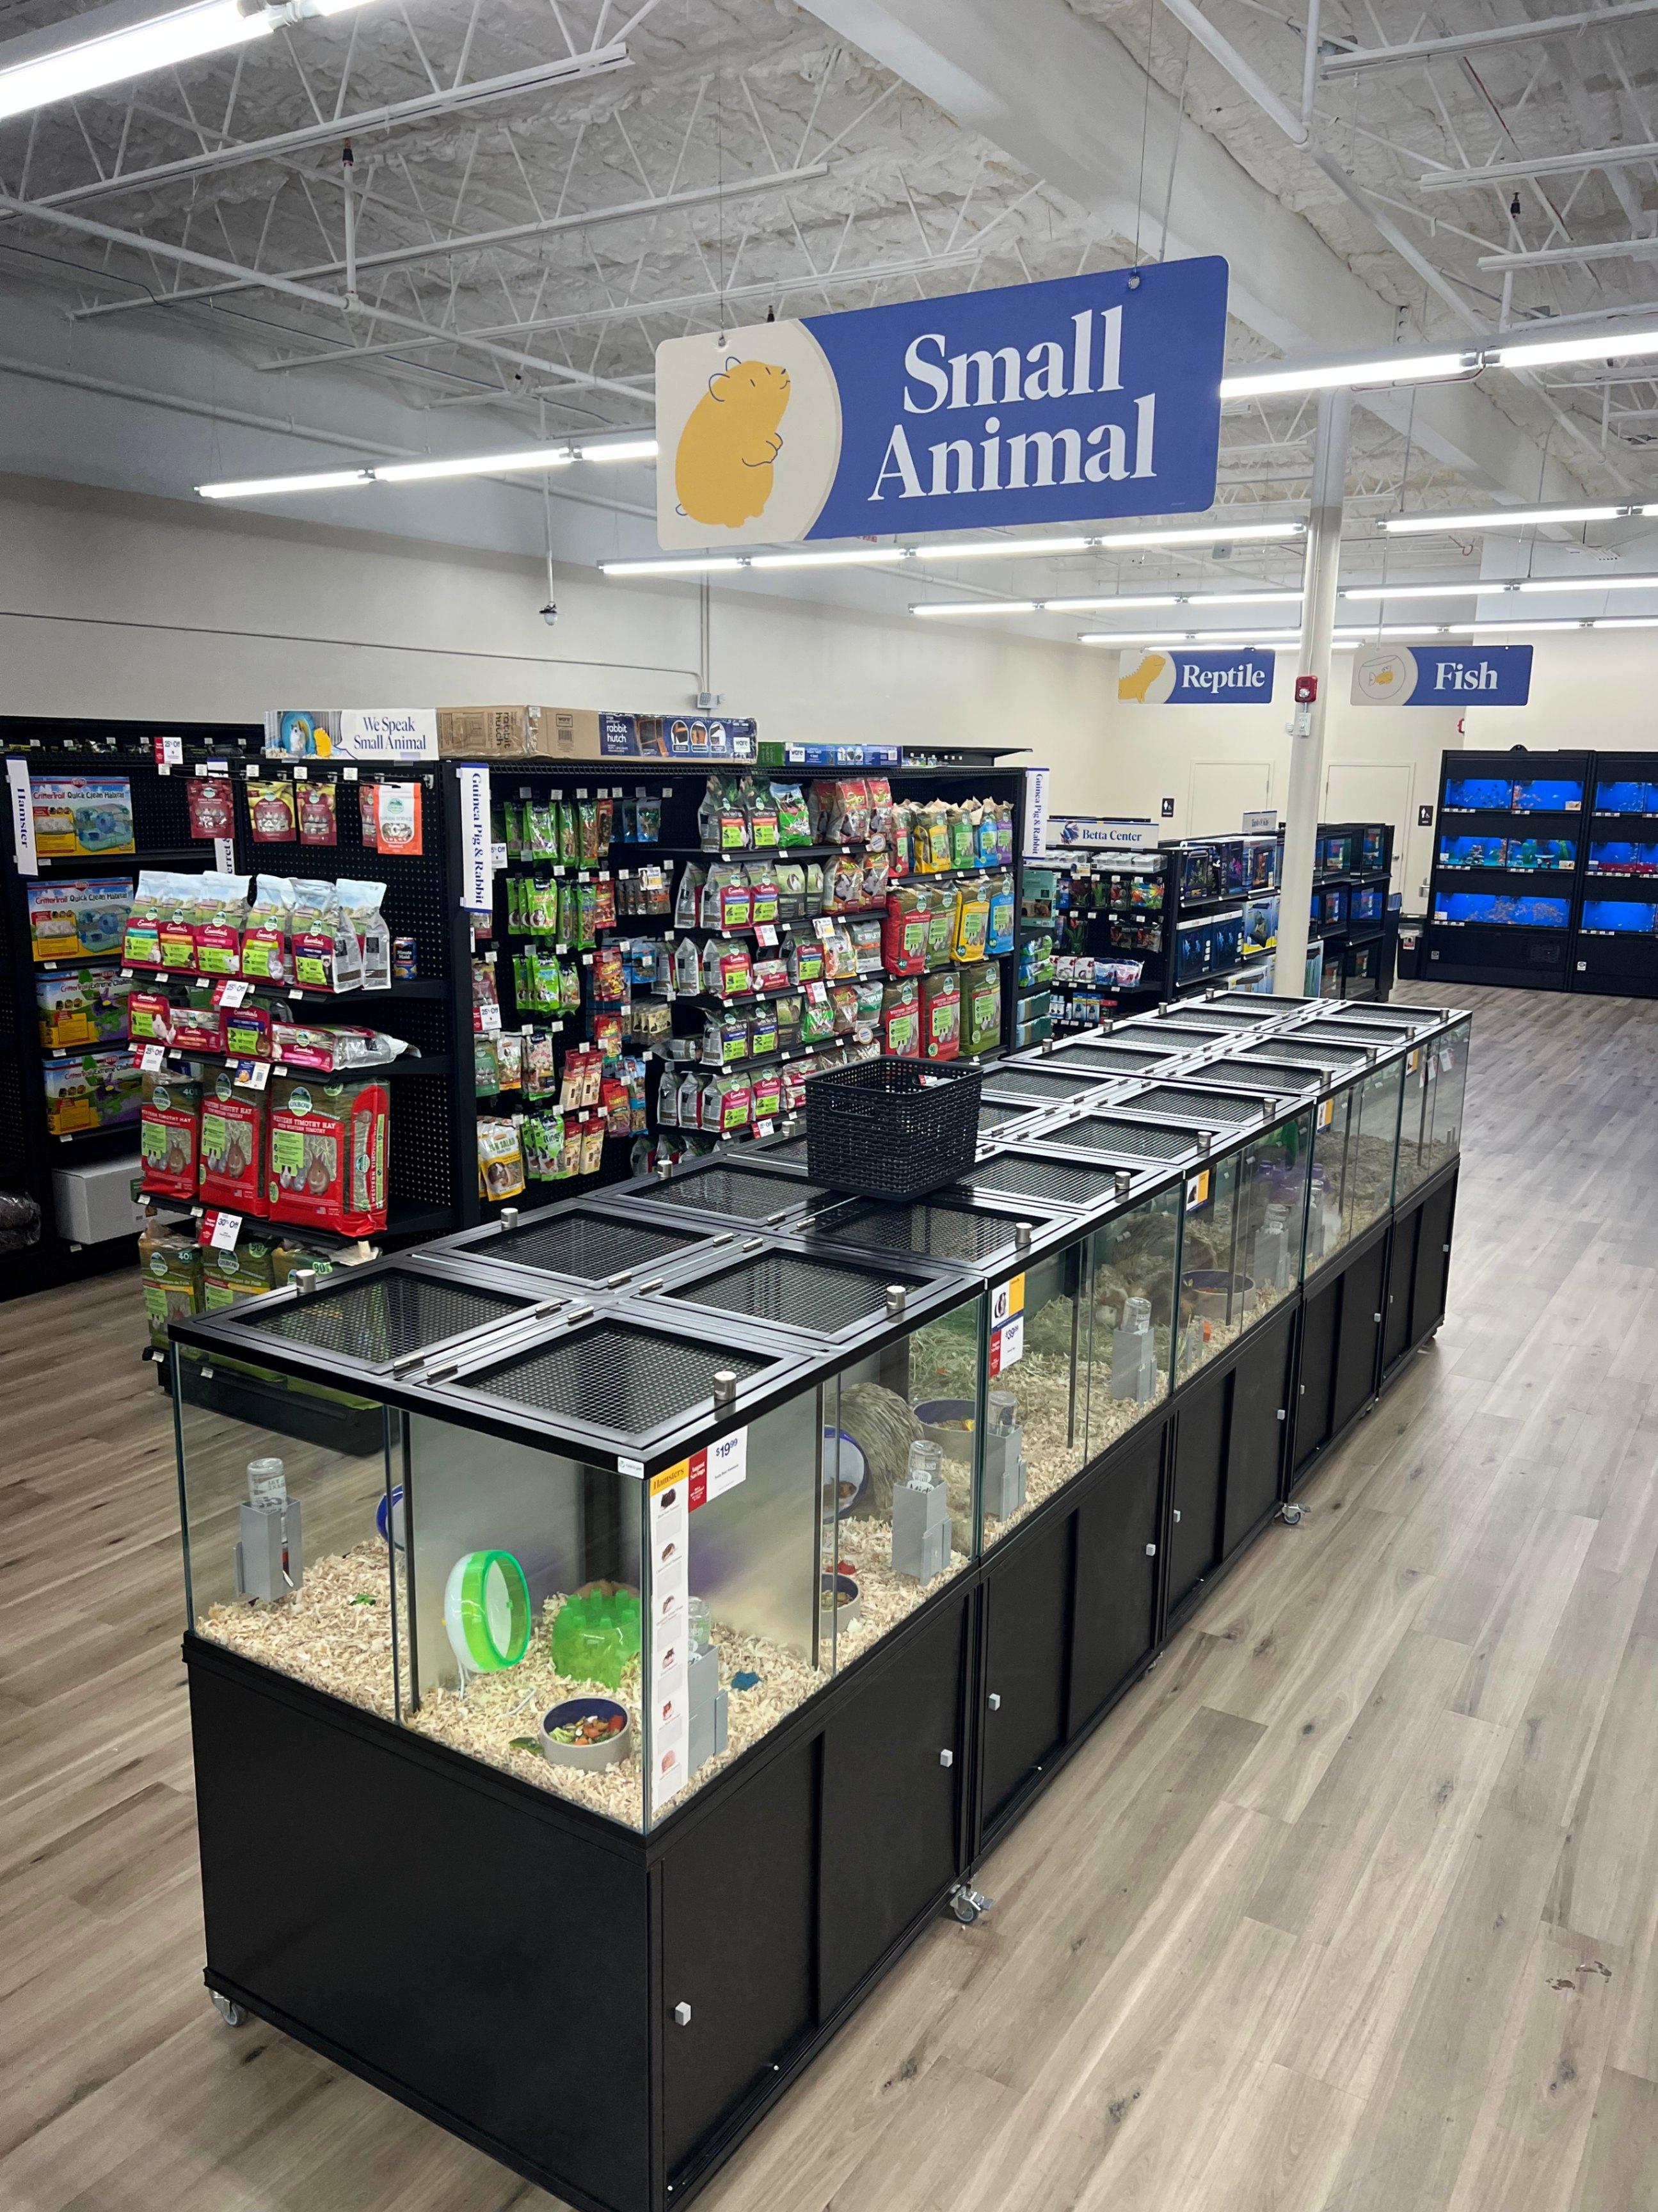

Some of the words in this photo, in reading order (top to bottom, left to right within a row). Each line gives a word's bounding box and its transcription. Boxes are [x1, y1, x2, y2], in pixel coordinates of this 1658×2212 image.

[903, 304, 1124, 415] Small
[867, 392, 1158, 502] Animal
[1181, 663, 1266, 694] Reptile
[1433, 661, 1499, 691] Fish
[363, 716, 381, 732] We
[383, 717, 416, 739] Speak
[502, 712, 512, 749] rabbit
[607, 723, 628, 733] rabbit
[607, 734, 626, 743] hutch
[354, 734, 384, 750] Small
[385, 733, 426, 750] Animal
[67, 791, 85, 799] Quick
[472, 773, 482, 820] Guinea
[1035, 773, 1043, 803] Guinea
[17, 788, 28, 849] Hamster
[1033, 805, 1042, 817] Pig
[472, 824, 483, 846] Pig
[1032, 827, 1040, 854] Rabbit
[1083, 830, 1107, 840] Betta
[1110, 830, 1142, 842] Center
[474, 848, 483, 856] &
[474, 860, 484, 904] Rabbit
[61, 984, 88, 993] CritterTrail
[90, 981, 112, 990] Extreme
[94, 1066, 116, 1075] Extreme
[294, 1119, 321, 1128] TIMOTHY
[543, 1132, 561, 1144] Rings
[653, 1468, 685, 1490] Hamsters
